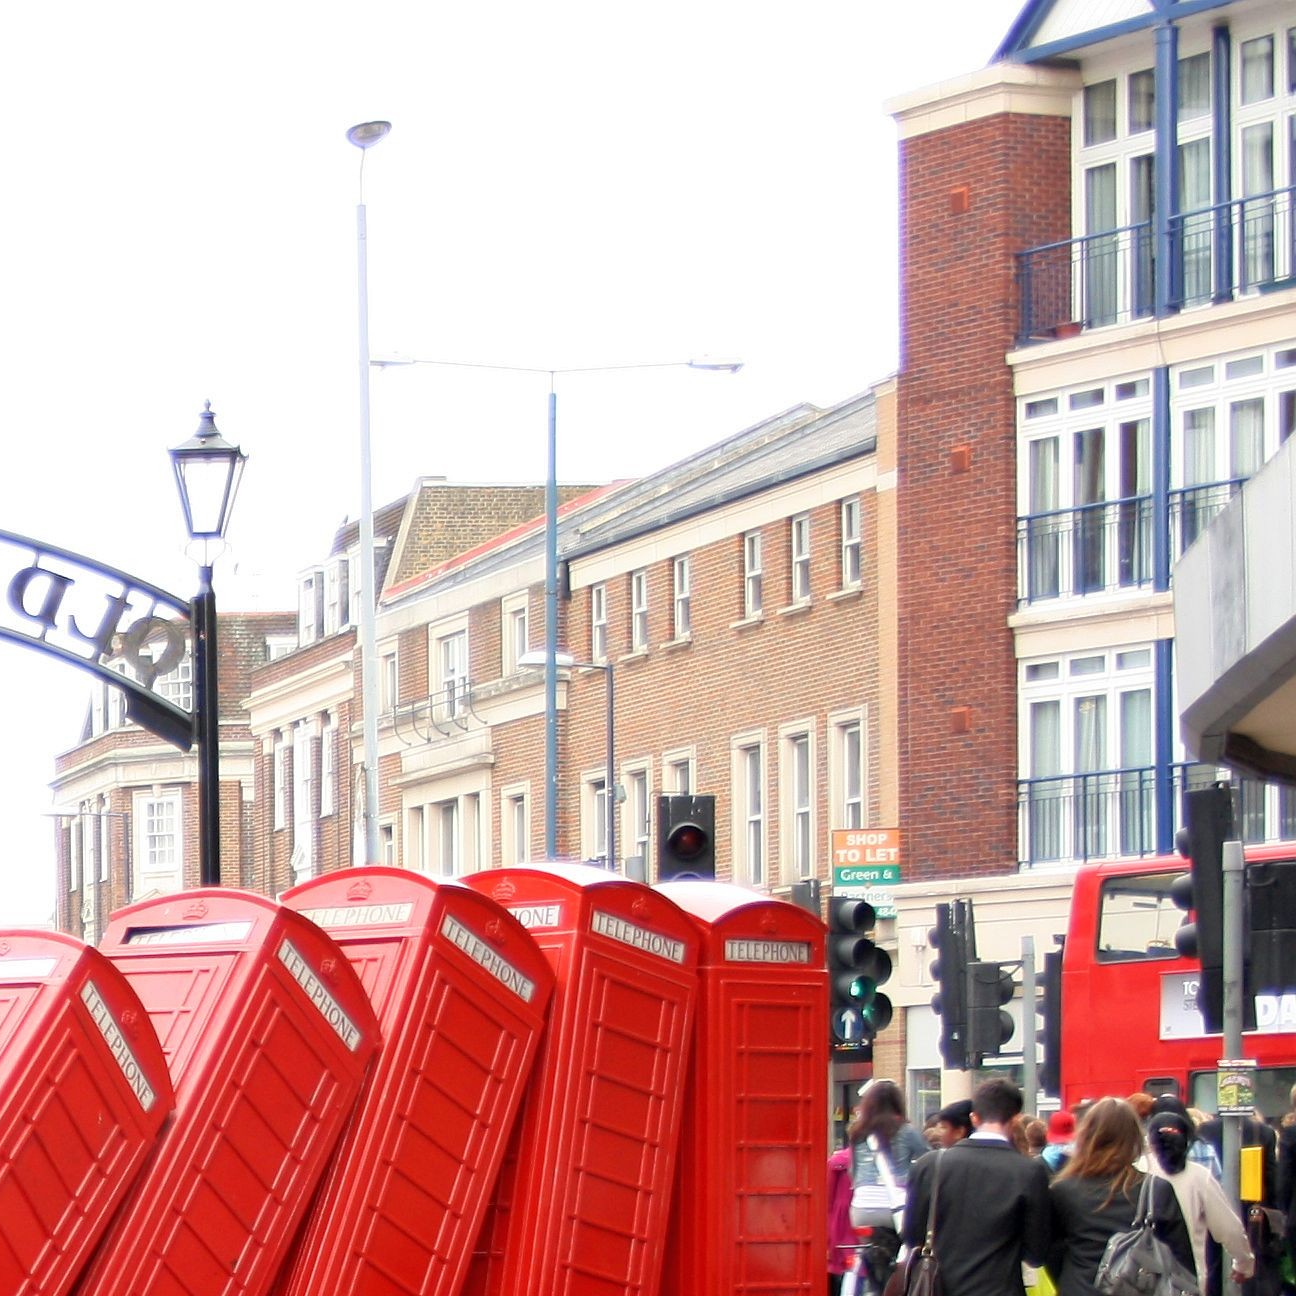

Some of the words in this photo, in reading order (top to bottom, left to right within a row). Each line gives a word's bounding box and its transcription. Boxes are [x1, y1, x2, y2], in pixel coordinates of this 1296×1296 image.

[836, 848, 861, 863] TO
[865, 847, 899, 862] LET
[846, 833, 887, 846] SHOP
[840, 868, 879, 881] Green
[882, 869, 893, 880] &
[596, 913, 682, 961] TELEPHONE
[728, 942, 806, 961] TELEPHONE
[447, 920, 528, 999] TELEPHONE
[283, 943, 358, 1047] TELEPHONE
[84, 984, 150, 1106] TELEPHONE
